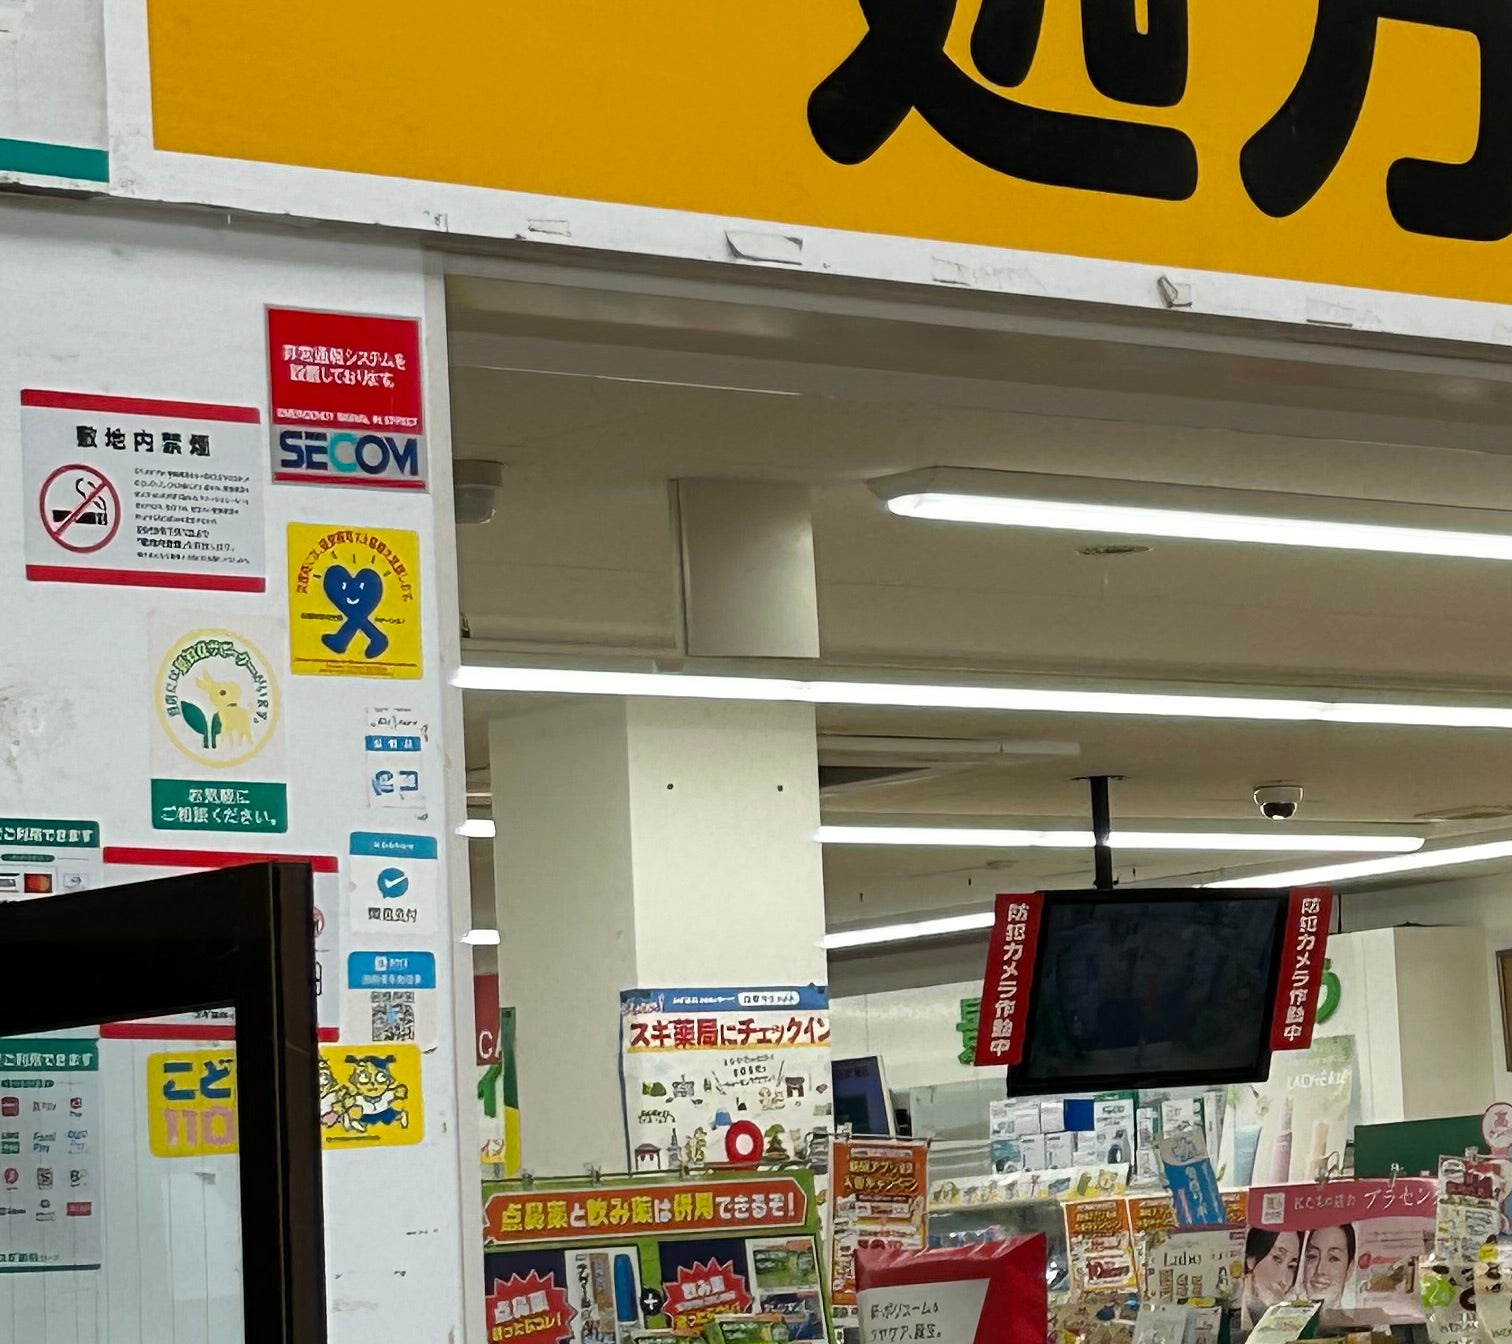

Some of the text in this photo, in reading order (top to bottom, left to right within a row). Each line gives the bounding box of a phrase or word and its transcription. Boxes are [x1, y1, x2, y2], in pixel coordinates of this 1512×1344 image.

[279, 430, 420, 476] SECOM
[0, 827, 93, 843] ご利用できます
[989, 903, 1029, 1056] 防犯カメラ作動中
[1283, 897, 1321, 1042] 防犯カメラ作動中
[630, 1017, 832, 1048] スギ薬局にチェックイン
[0, 1053, 92, 1067] ご利用できます
